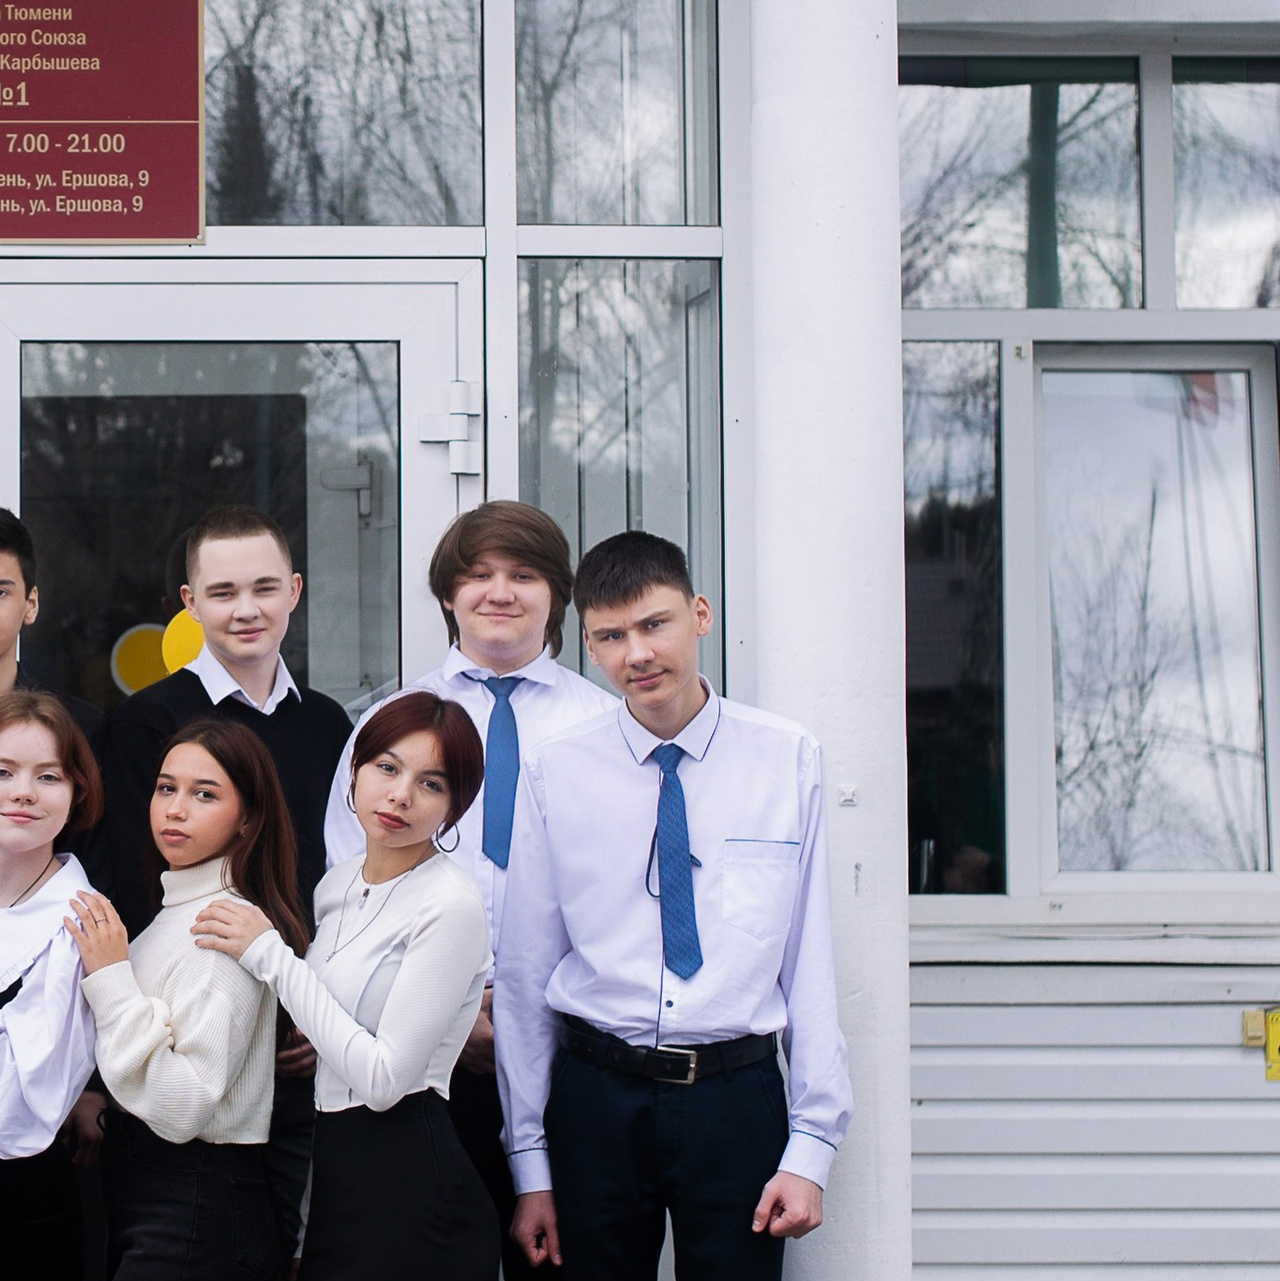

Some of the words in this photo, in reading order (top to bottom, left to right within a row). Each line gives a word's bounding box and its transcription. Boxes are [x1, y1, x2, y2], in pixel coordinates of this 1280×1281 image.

[4, 4, 73, 21] Тюмени
[31, 28, 87, 46] Союза
[0, 52, 101, 74] Карбышева
[5, 132, 51, 154] 7.00
[66, 132, 127, 154] 21.00
[35, 173, 58, 191] ул.
[61, 169, 135, 191] Ершова,
[138, 169, 151, 188] 9
[29, 199, 52, 217] ул.
[55, 195, 129, 217] Ершова,
[132, 195, 145, 214] 9
